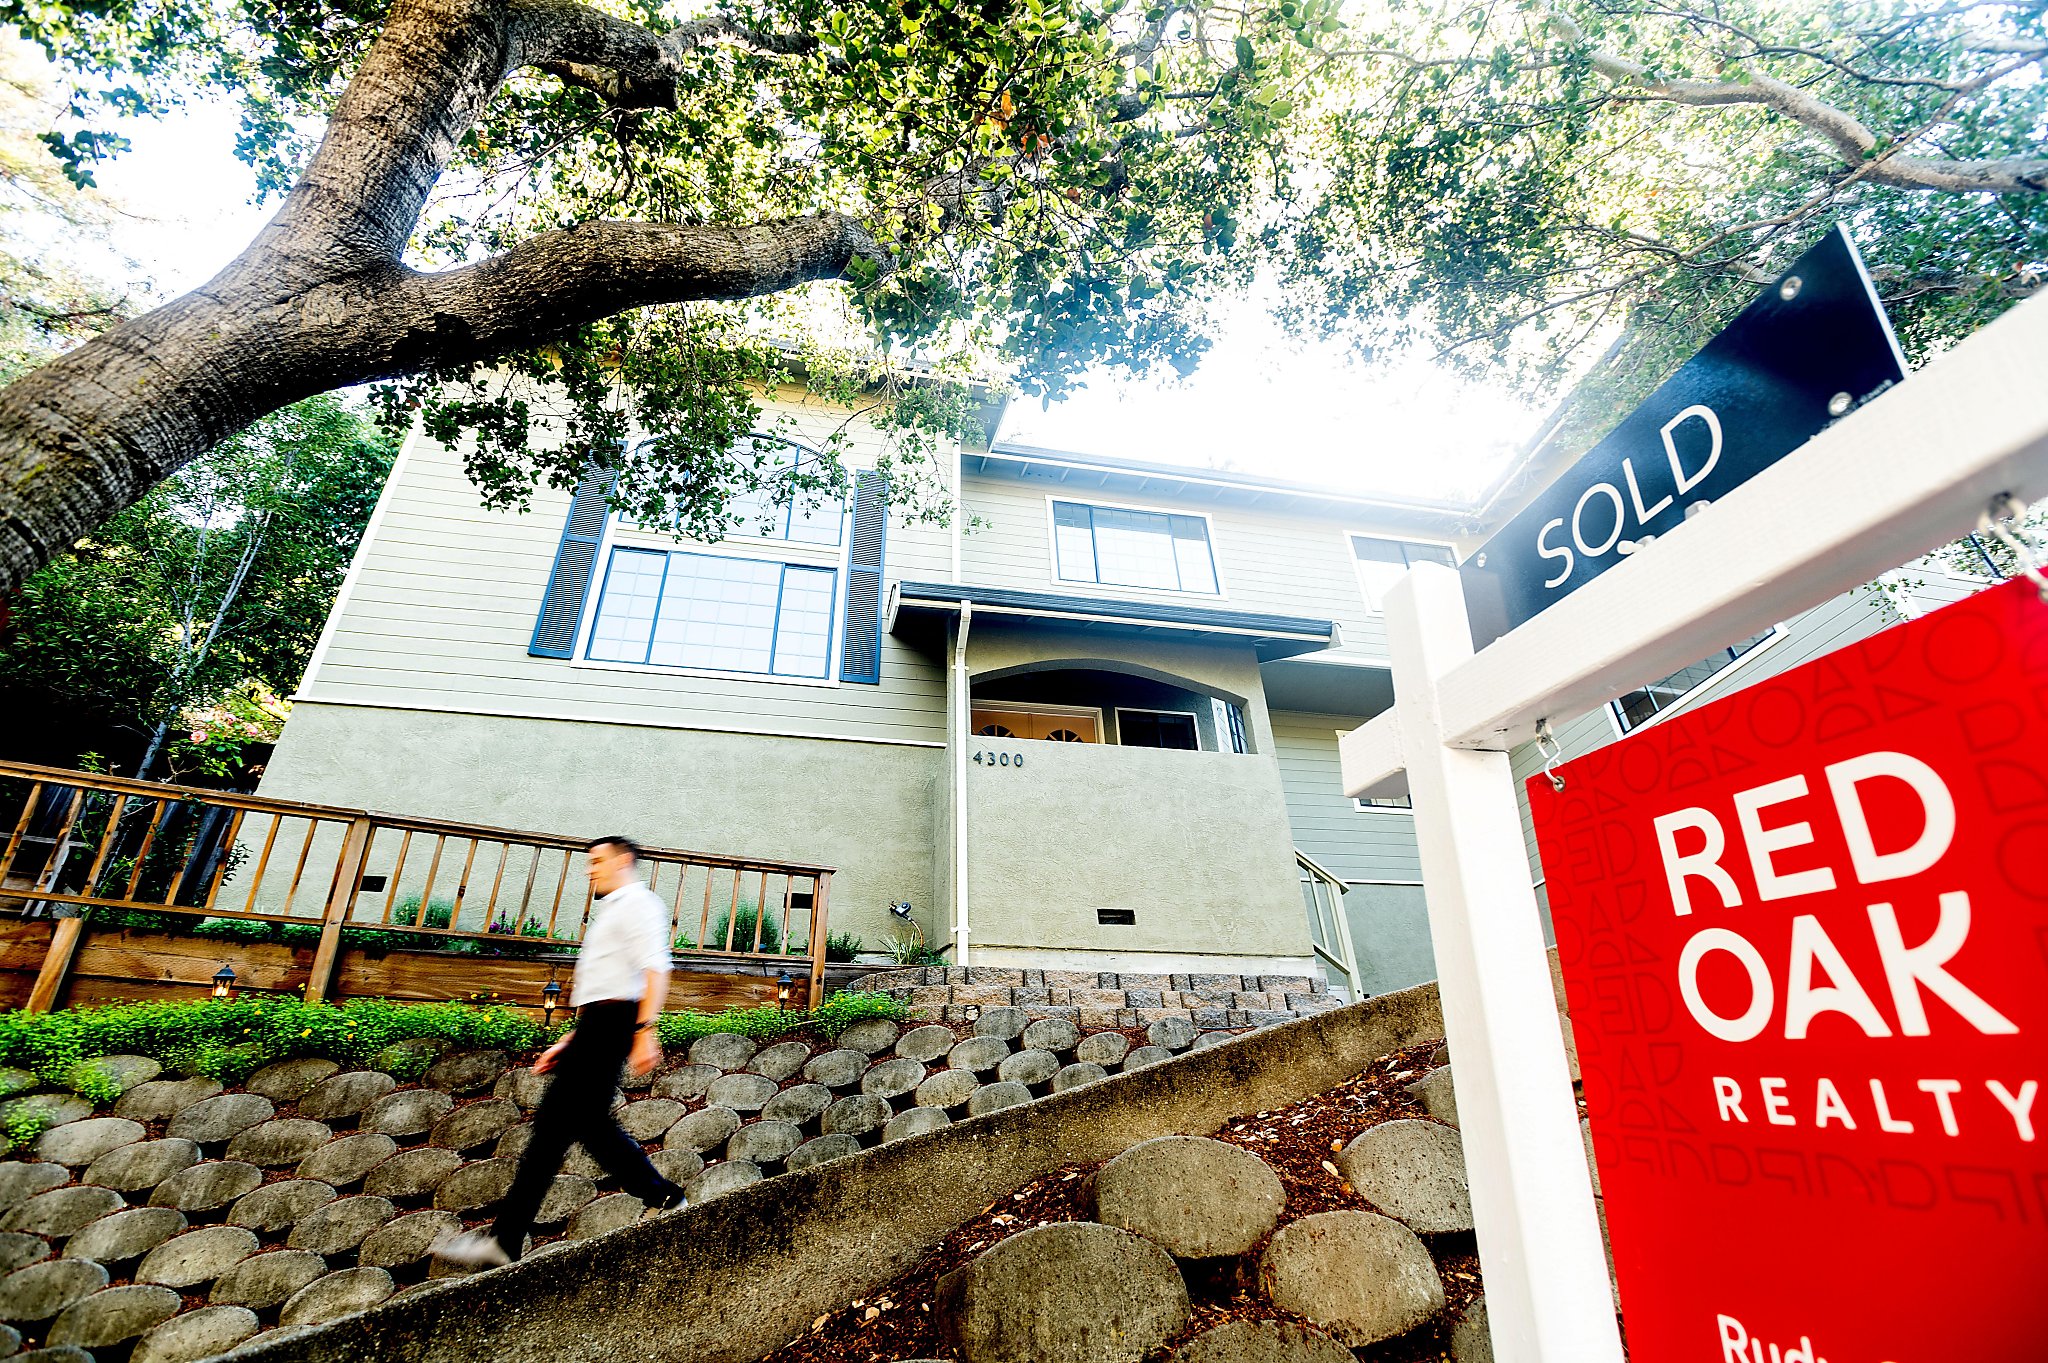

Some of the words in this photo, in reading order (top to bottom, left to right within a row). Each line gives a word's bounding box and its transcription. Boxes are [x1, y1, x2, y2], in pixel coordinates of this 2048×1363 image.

[1536, 404, 1723, 590] SOLD
[973, 751, 1024, 768] 4300
[1653, 751, 1956, 917] RED
[1678, 890, 2020, 1043] OAK
[1712, 1076, 2038, 1142] REALTY
